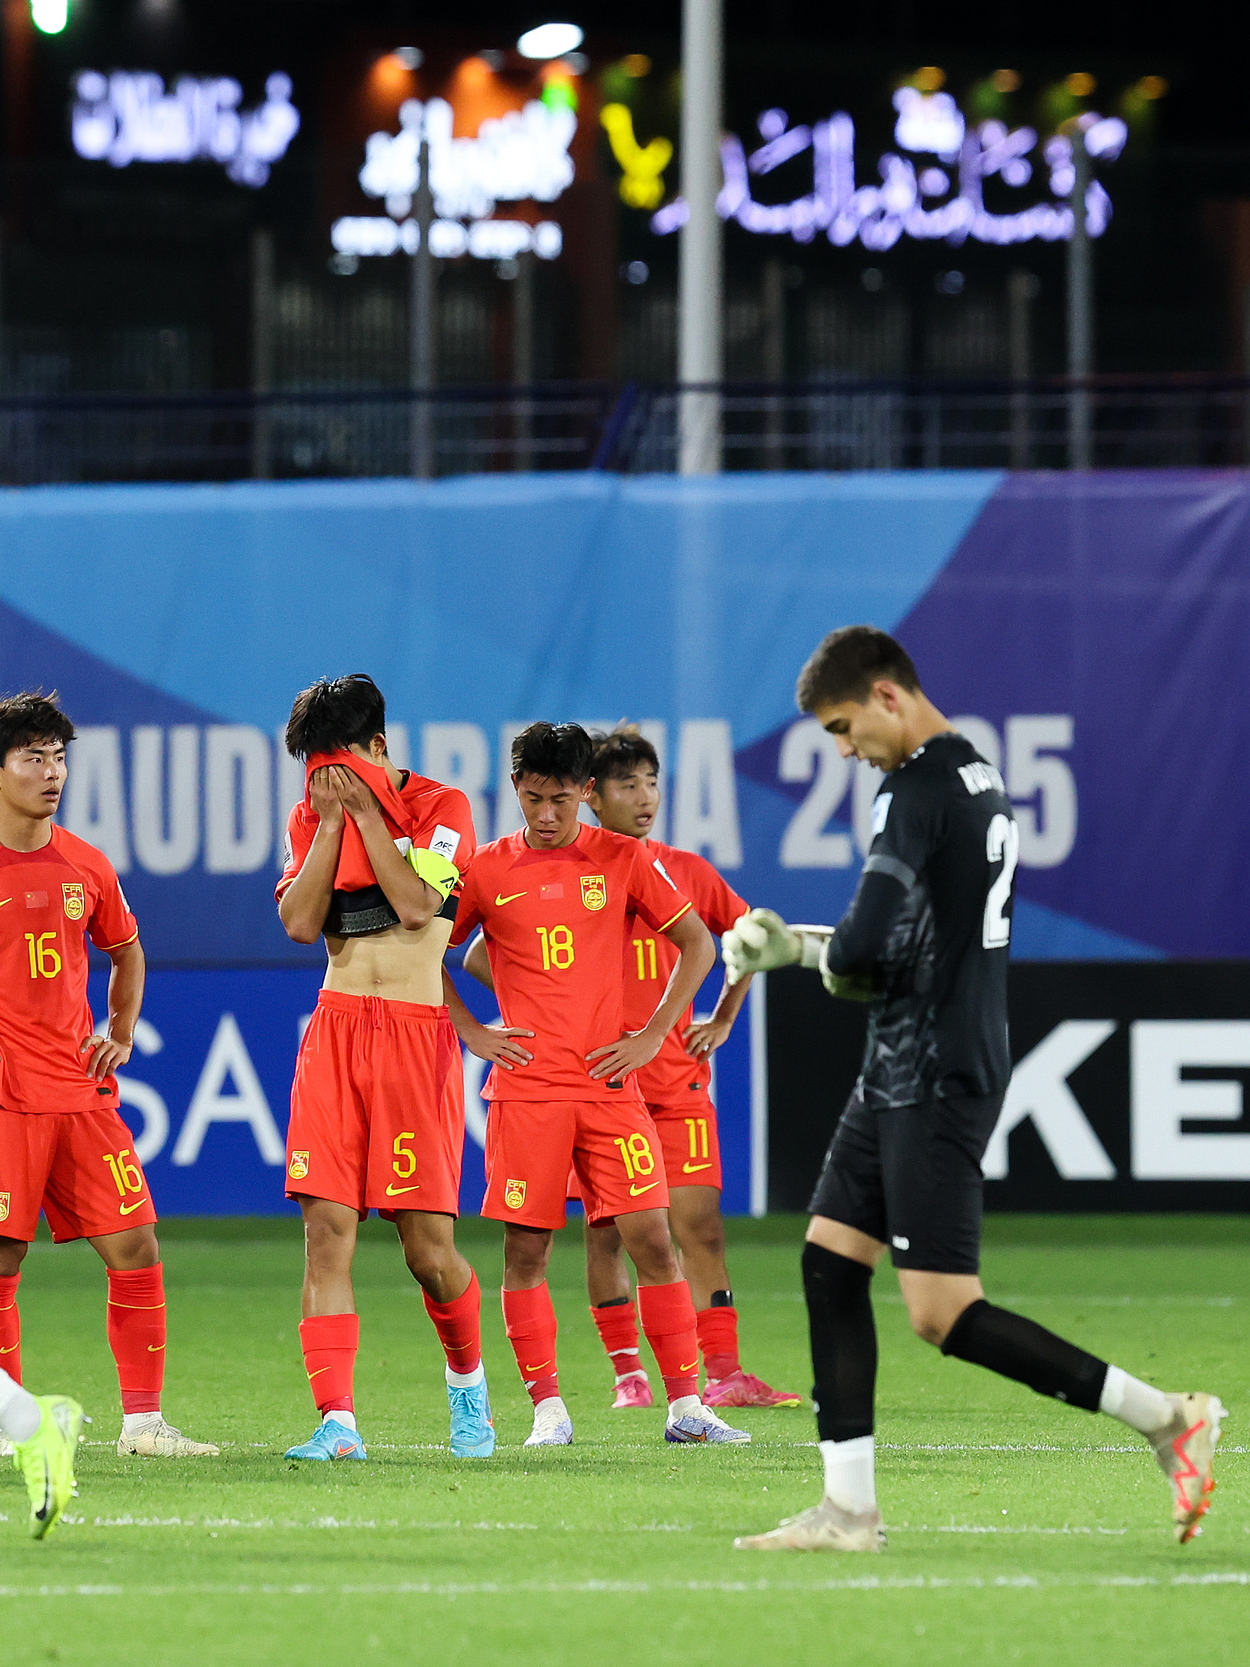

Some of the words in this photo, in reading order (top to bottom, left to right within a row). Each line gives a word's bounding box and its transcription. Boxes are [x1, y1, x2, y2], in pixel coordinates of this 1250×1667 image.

[582, 877, 604, 886] CFA
[24, 931, 62, 979] 16
[535, 924, 575, 971] 18
[632, 939, 657, 980] 11
[392, 1132, 417, 1178] 5
[613, 1132, 656, 1179] 18
[685, 1118, 709, 1158] 11
[102, 1149, 142, 1197] 16
